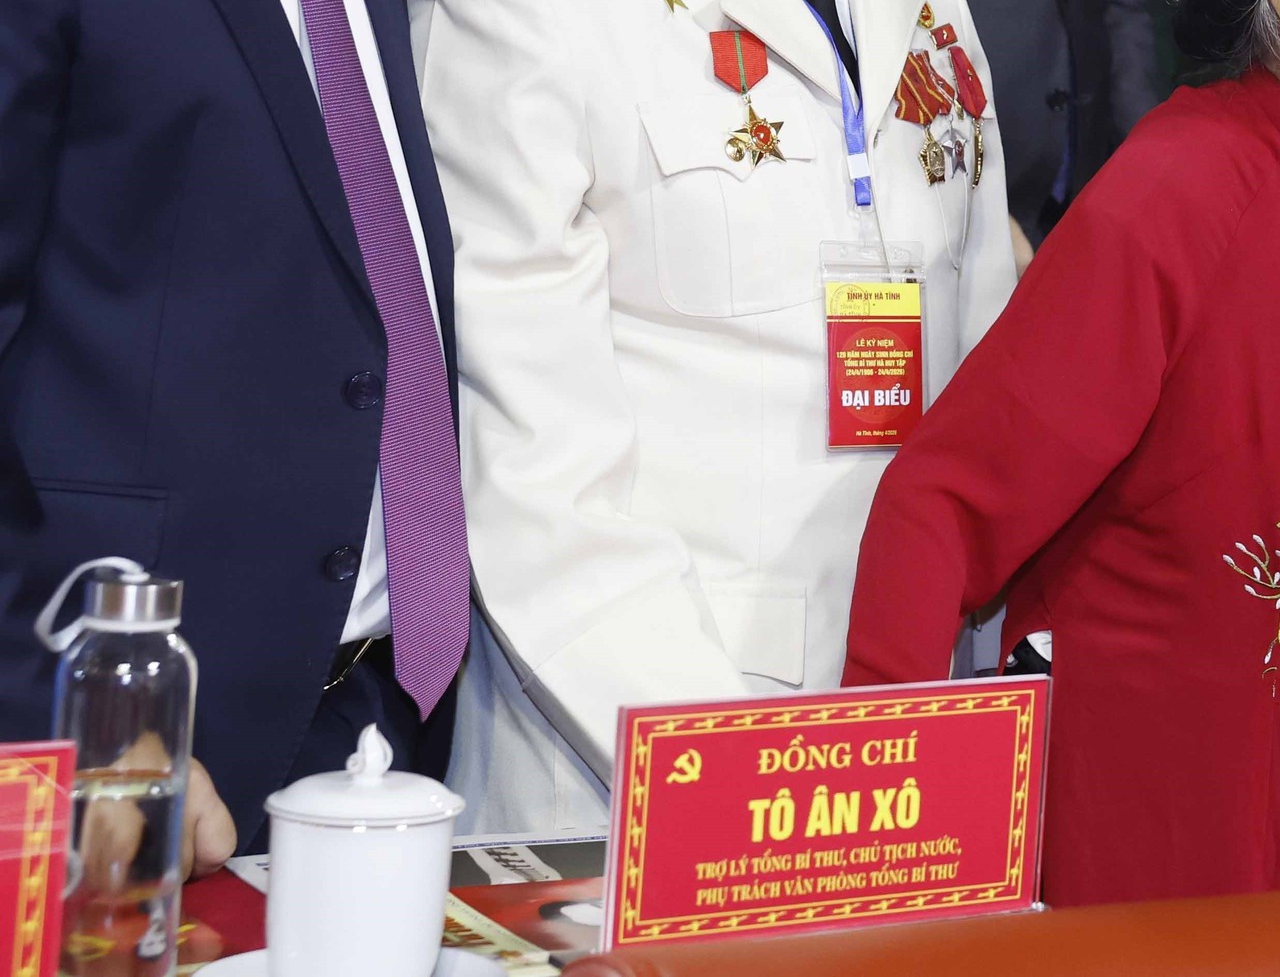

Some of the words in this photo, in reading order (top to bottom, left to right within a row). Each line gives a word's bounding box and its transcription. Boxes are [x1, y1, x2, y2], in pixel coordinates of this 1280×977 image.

[847, 290, 862, 300] TỈNH
[864, 290, 872, 300] ỦY
[874, 291, 884, 300] HÀ
[885, 291, 901, 300] TĨNH
[847, 350, 860, 358] NĂM
[860, 350, 875, 358] NGÀY
[904, 350, 914, 358] CHÍ
[856, 338, 865, 347] LỄ
[866, 338, 876, 347] KỶ
[877, 338, 894, 348] NIỆM
[859, 359, 865, 367] BÍ
[896, 359, 906, 368] TẬP
[841, 389, 870, 410] ĐẠI
[874, 383, 911, 406] BIỂU
[757, 733, 853, 774] ĐỒNG
[861, 730, 918, 766] CHÍ
[748, 787, 795, 842] TÔ
[805, 785, 860, 837] ÂN
[869, 777, 921, 831] XÔ
[695, 858, 728, 882] TRỢ
[729, 854, 749, 877] LÝ
[751, 848, 792, 874] TỔNG
[795, 848, 811, 870] BÍ
[813, 847, 847, 868] THƯ,
[849, 840, 880, 864] CHỦ
[883, 842, 917, 864] TỊCH
[920, 834, 962, 857] NƯỚC,
[696, 886, 728, 907] PHỤ
[731, 879, 781, 902] TRÁCH
[783, 875, 814, 896] VĂN
[816, 870, 867, 893] PHÒNG
[870, 862, 908, 887] TỔNG
[911, 862, 927, 883] BÍ
[929, 861, 960, 881] THƯ
